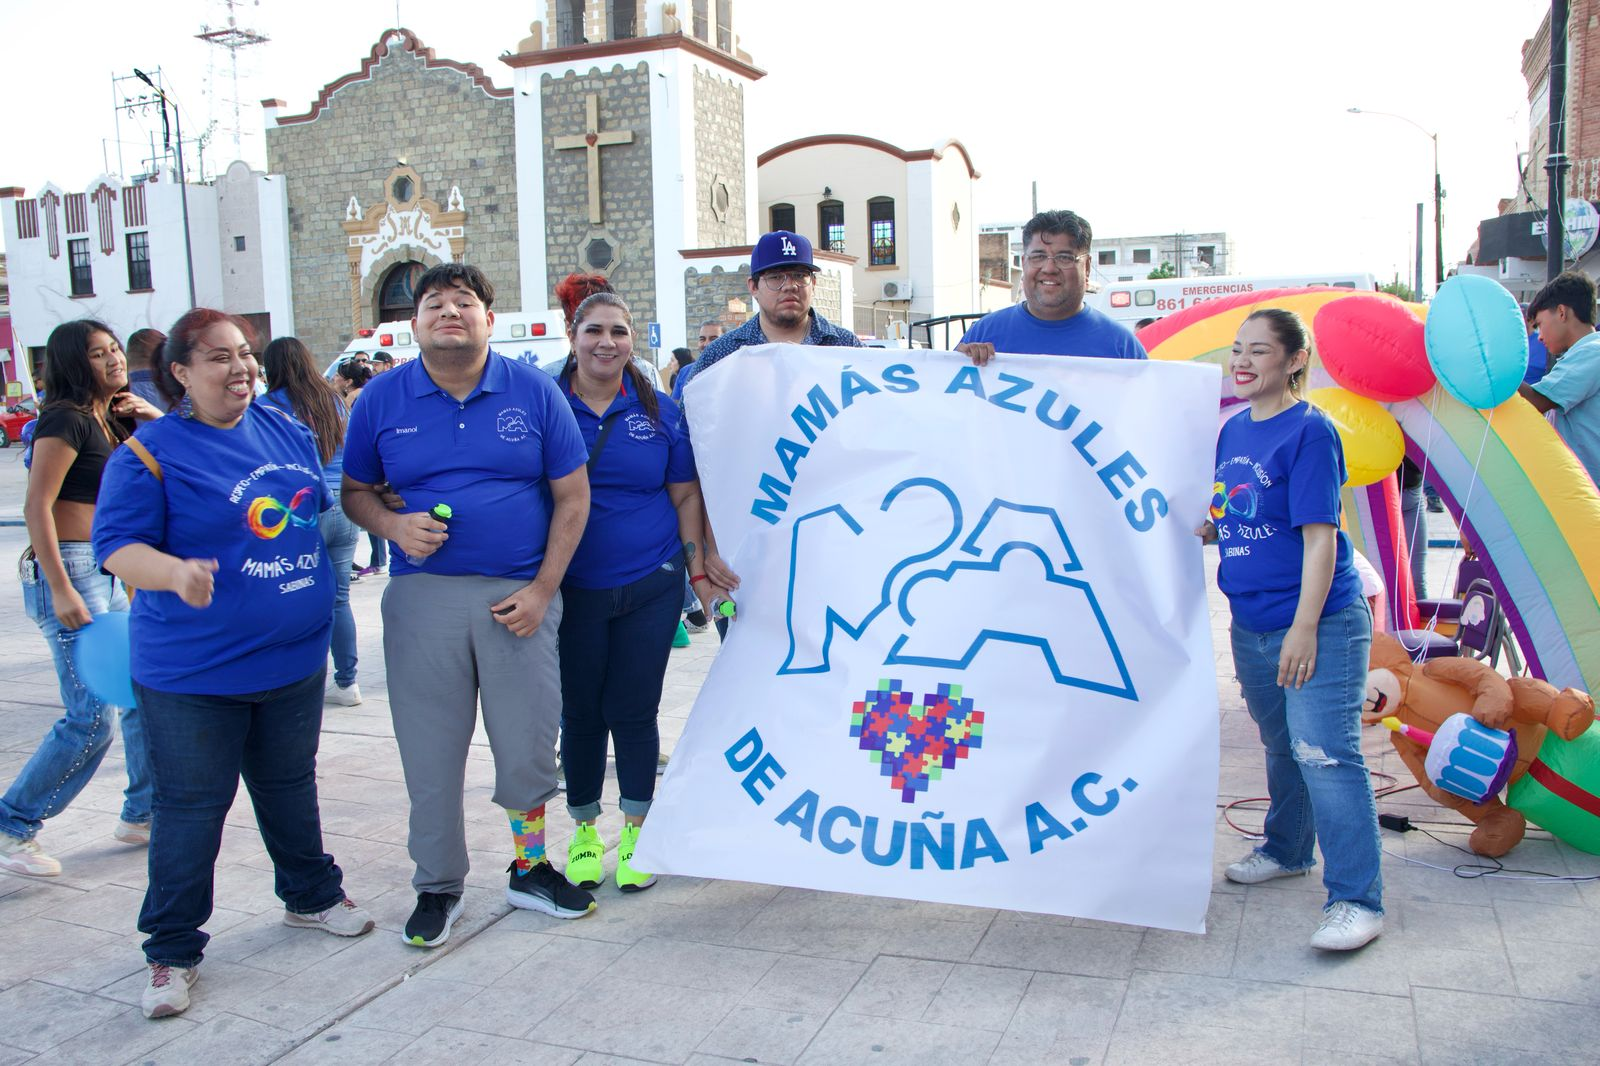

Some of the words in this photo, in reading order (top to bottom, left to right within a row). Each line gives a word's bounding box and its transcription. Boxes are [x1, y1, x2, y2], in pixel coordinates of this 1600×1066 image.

[780, 237, 797, 256] LA
[1182, 284, 1253, 296] EMERGENCIAS
[750, 363, 920, 526] MAMÁS
[944, 365, 1169, 532] AZULES
[1237, 523, 1278, 540] AZULE
[241, 555, 294, 578] MAMÁS
[723, 726, 787, 806] DE
[774, 789, 1009, 871] ACUÑA
[1024, 771, 1140, 856] A.C.
